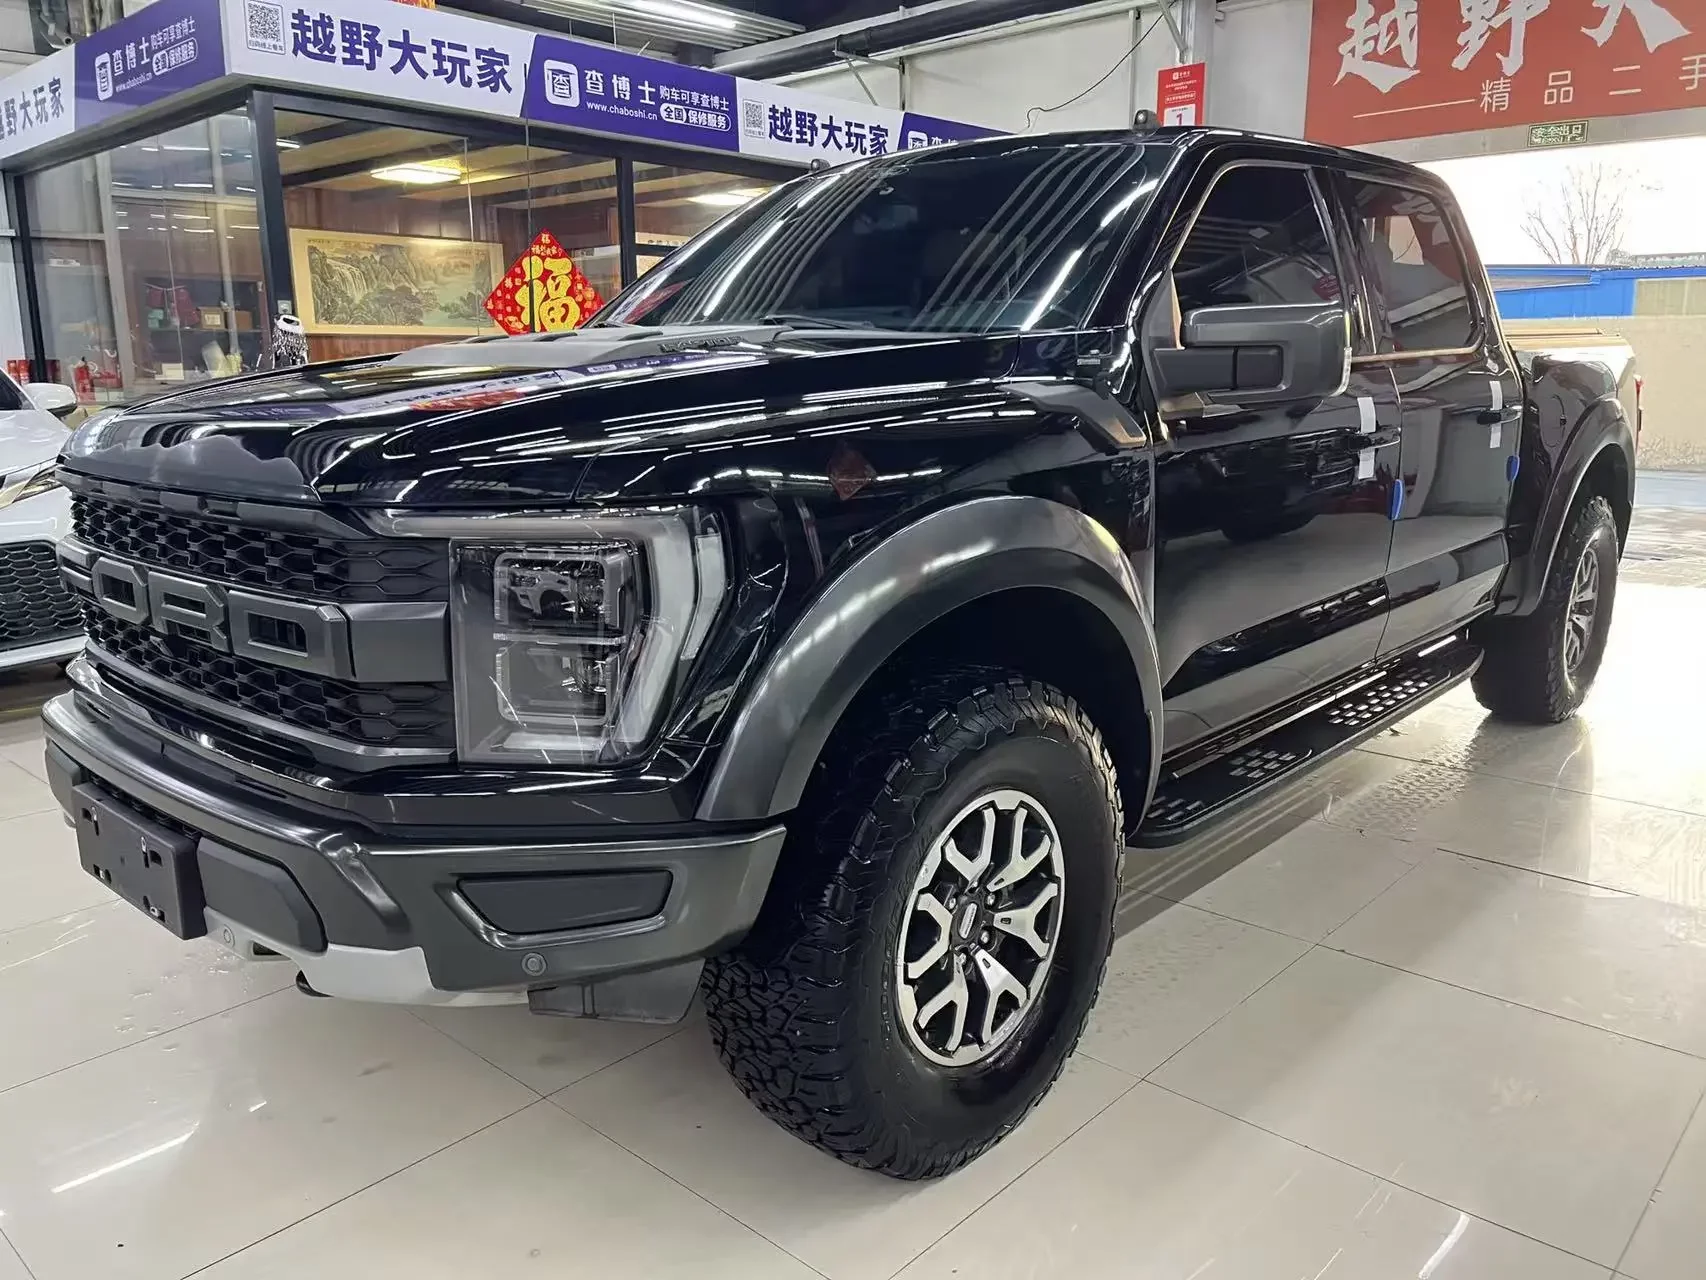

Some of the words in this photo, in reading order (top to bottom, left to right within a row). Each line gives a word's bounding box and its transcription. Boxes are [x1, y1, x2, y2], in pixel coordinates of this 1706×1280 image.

[112, 36, 150, 76] 查博士
[290, 8, 513, 94] 越野大玩家
[584, 69, 656, 106] 查博士
[659, 84, 730, 111] 购车可享查博士
[1479, 54, 1706, 114] 精品二手
[586, 101, 658, 121] www.chaboshi.cn
[664, 106, 684, 121] 全国
[688, 109, 727, 129] 保修服务
[768, 104, 889, 156] 越野大玩家
[514, 255, 581, 333] 福
[56, 533, 354, 681] FORD
